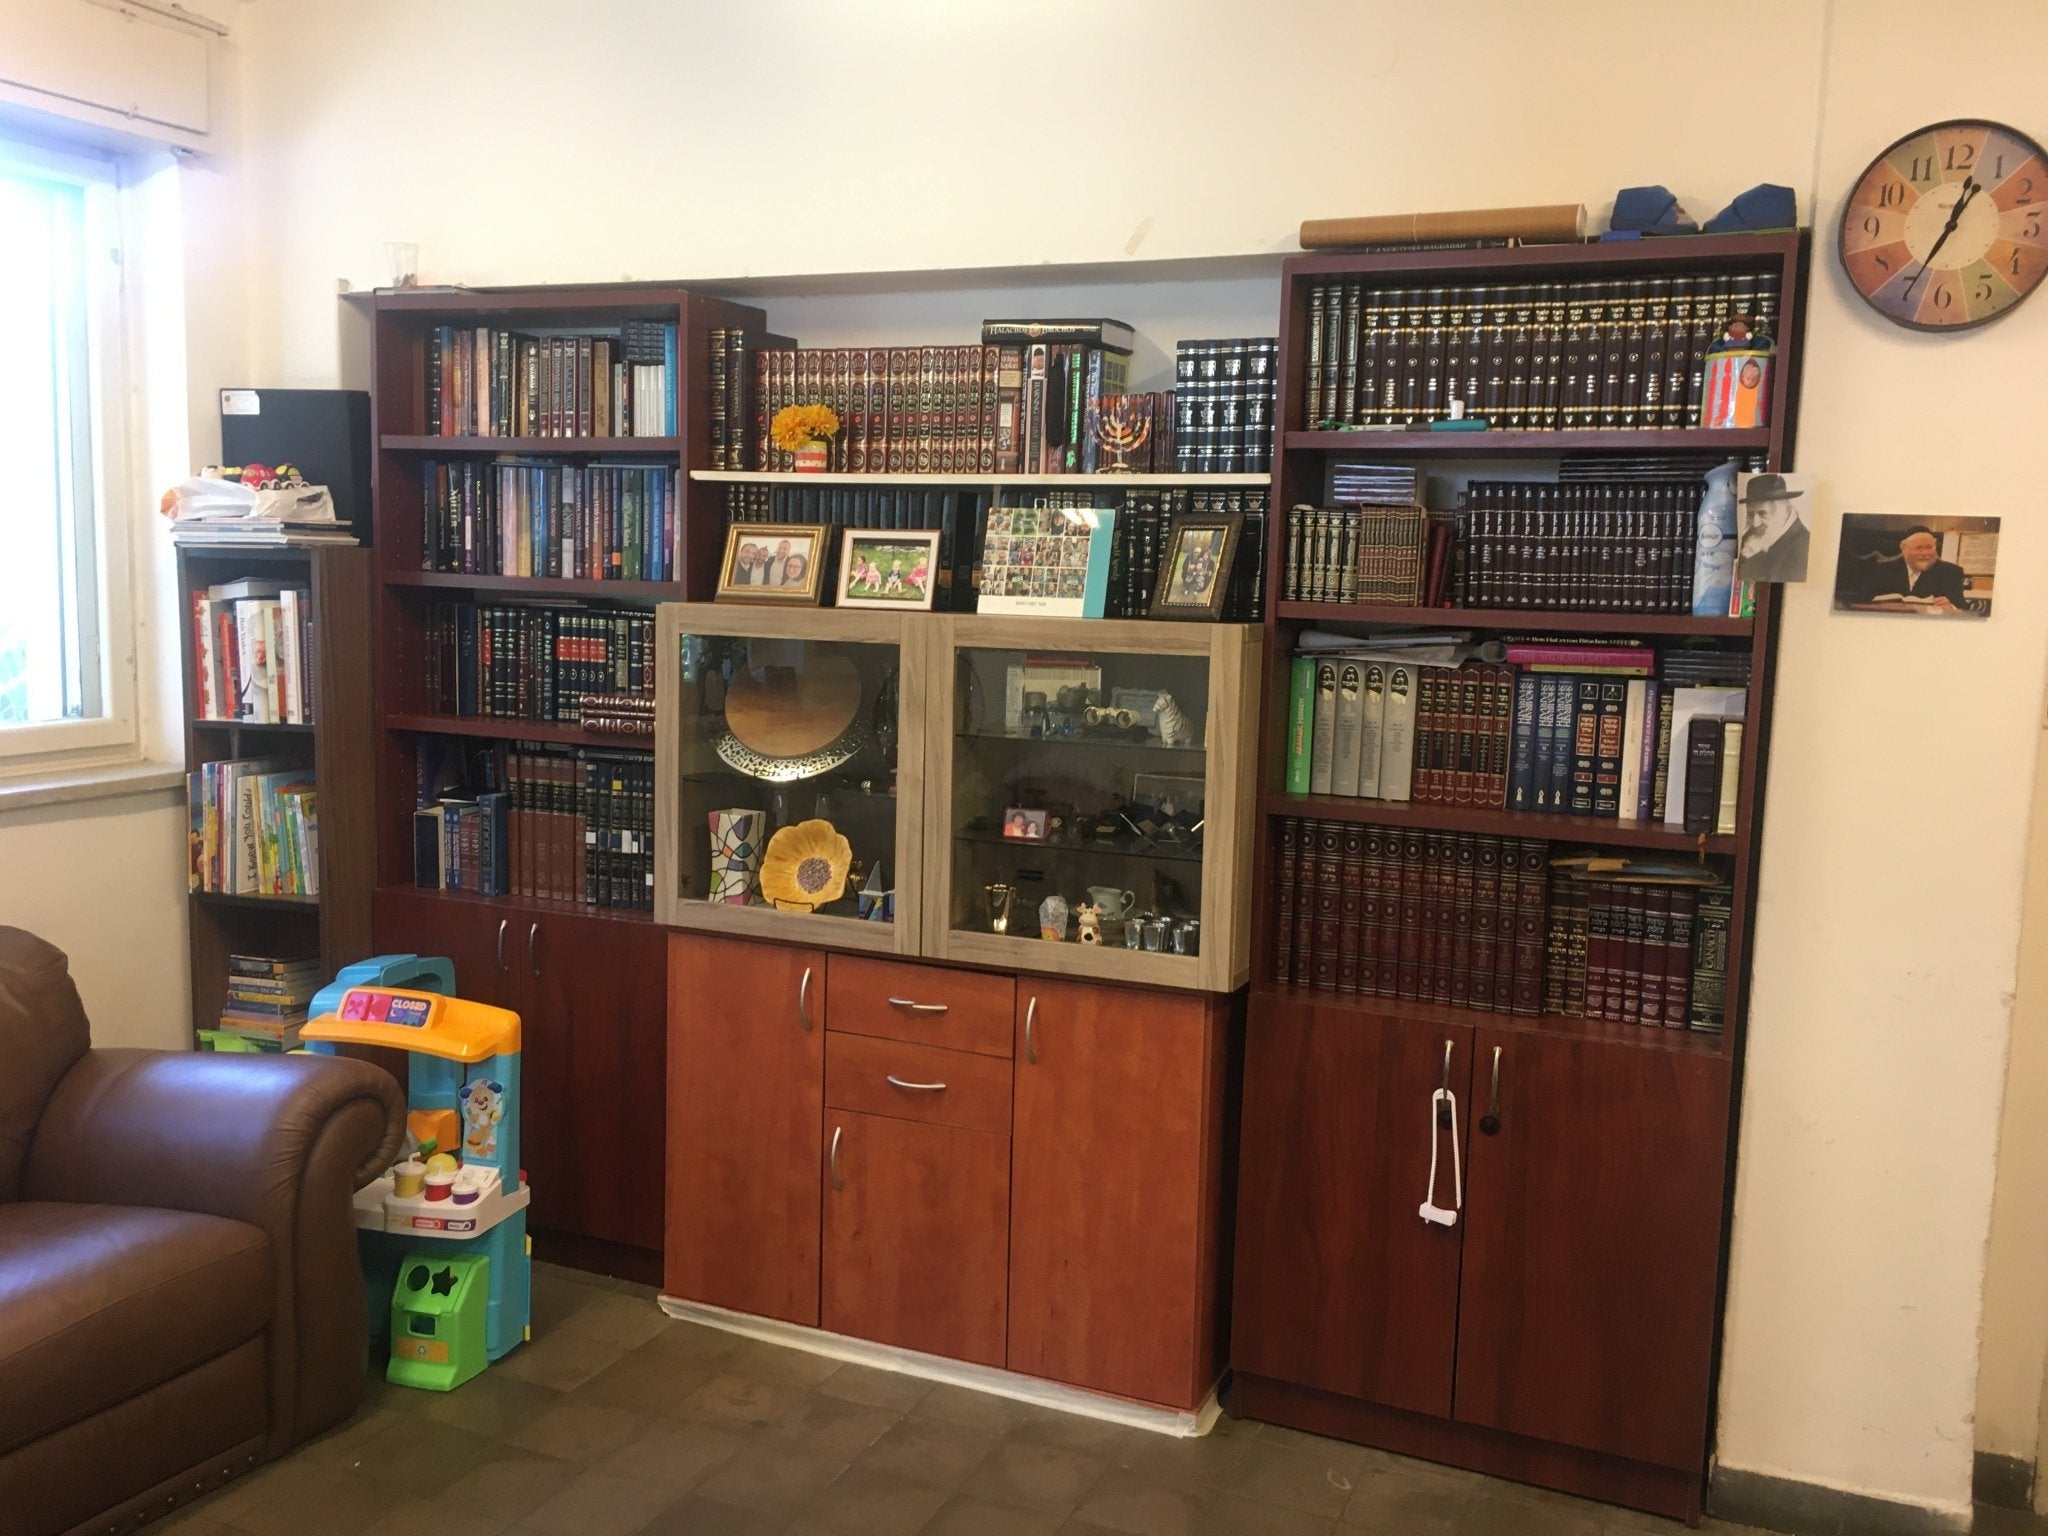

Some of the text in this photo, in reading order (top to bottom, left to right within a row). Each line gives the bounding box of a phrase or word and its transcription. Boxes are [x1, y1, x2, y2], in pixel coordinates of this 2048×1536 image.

[1909, 155, 1932, 181] 11
[1945, 144, 1975, 170] 12
[1993, 154, 2003, 179] 1
[1878, 182, 1905, 208] 10
[2015, 178, 2033, 204] 2
[1863, 215, 1881, 240] 9
[2023, 211, 2041, 238] 3
[2009, 247, 2022, 275] 4
[1902, 276, 1919, 301] 7
[1934, 282, 1952, 309] 6
[1975, 274, 1993, 301] 5
[391, 999, 428, 1012] CLOSED
